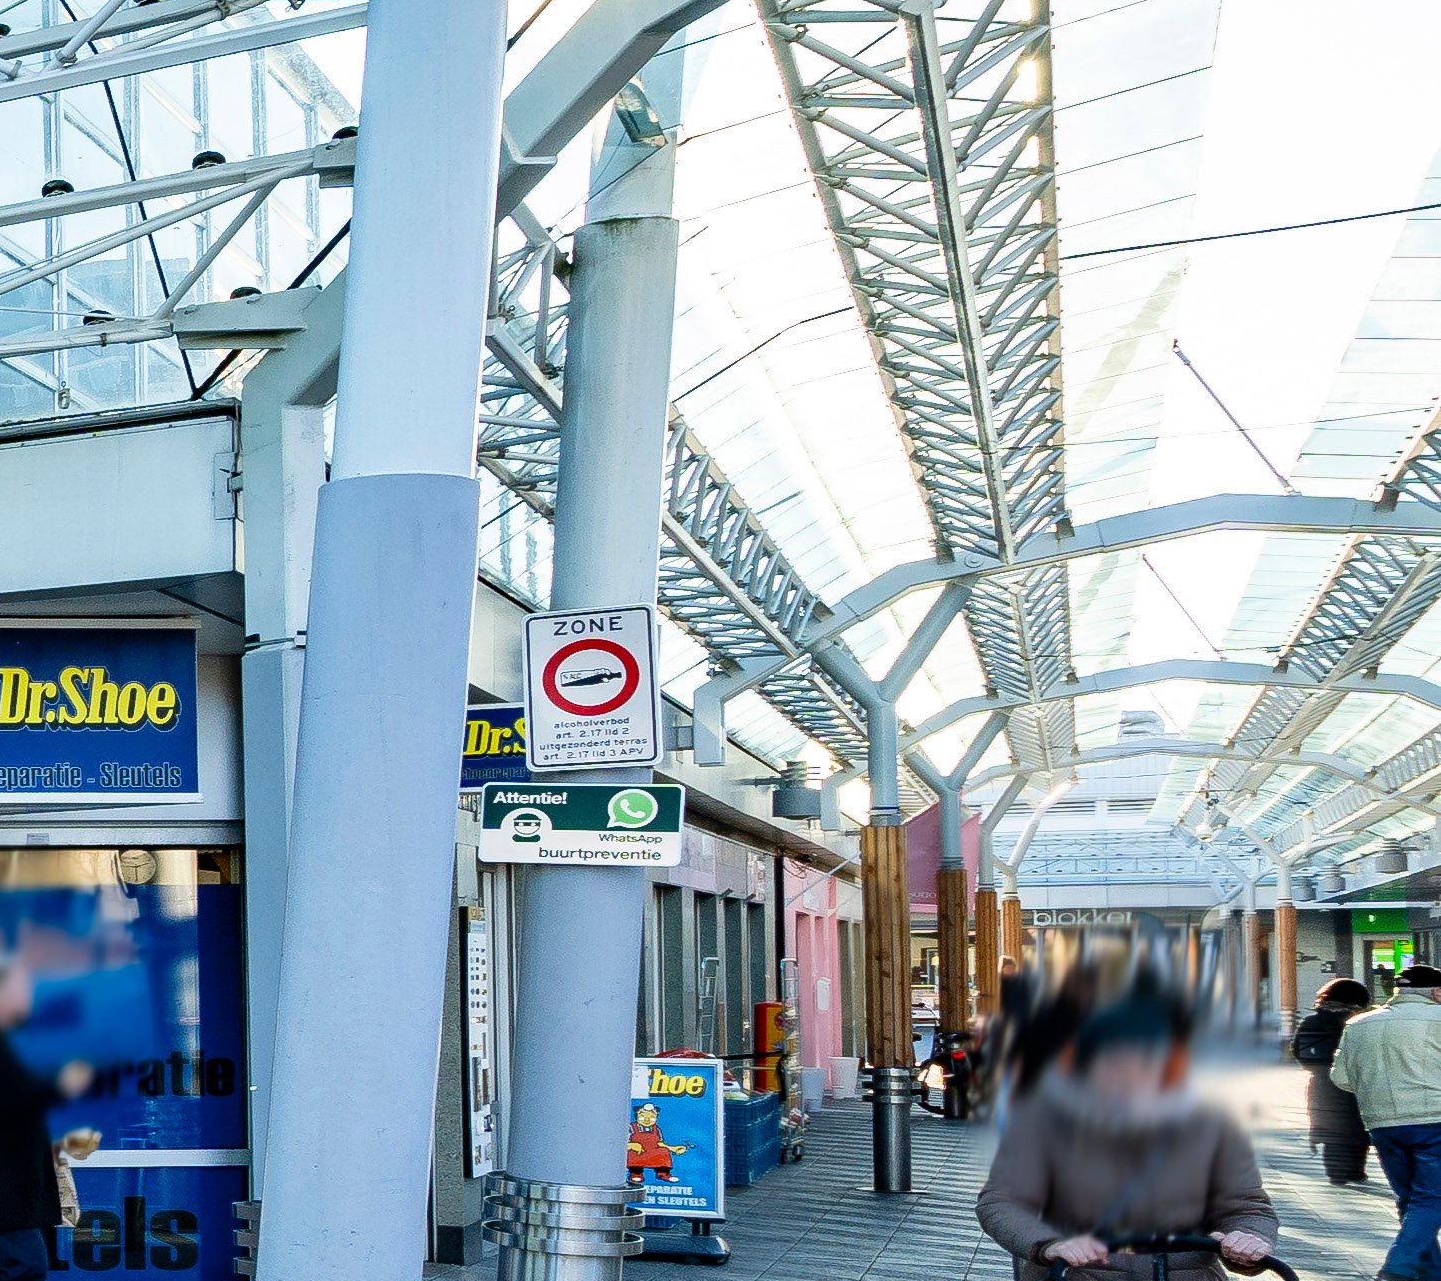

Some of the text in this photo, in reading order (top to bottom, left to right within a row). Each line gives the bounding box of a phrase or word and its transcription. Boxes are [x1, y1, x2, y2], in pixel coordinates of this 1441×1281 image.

[553, 615, 623, 636] ZONE
[554, 717, 630, 729] alcoholverbod
[461, 717, 527, 757] Dr.S
[556, 731, 574, 739] art.
[579, 729, 602, 737] 2.17
[604, 728, 618, 736] lid
[540, 737, 648, 751] uitgezonderd terras
[543, 747, 645, 761] art. 2.17 lid 3 APV
[100, 762, 182, 789] Sleutels
[493, 791, 567, 805] Attentie!
[599, 833, 663, 845] WhatsApp
[538, 847, 661, 861] buurtpreventie
[649, 1068, 707, 1098] hoe
[645, 1186, 693, 1196] EPARATIE
[658, 1195, 707, 1207] SLEUTELS
